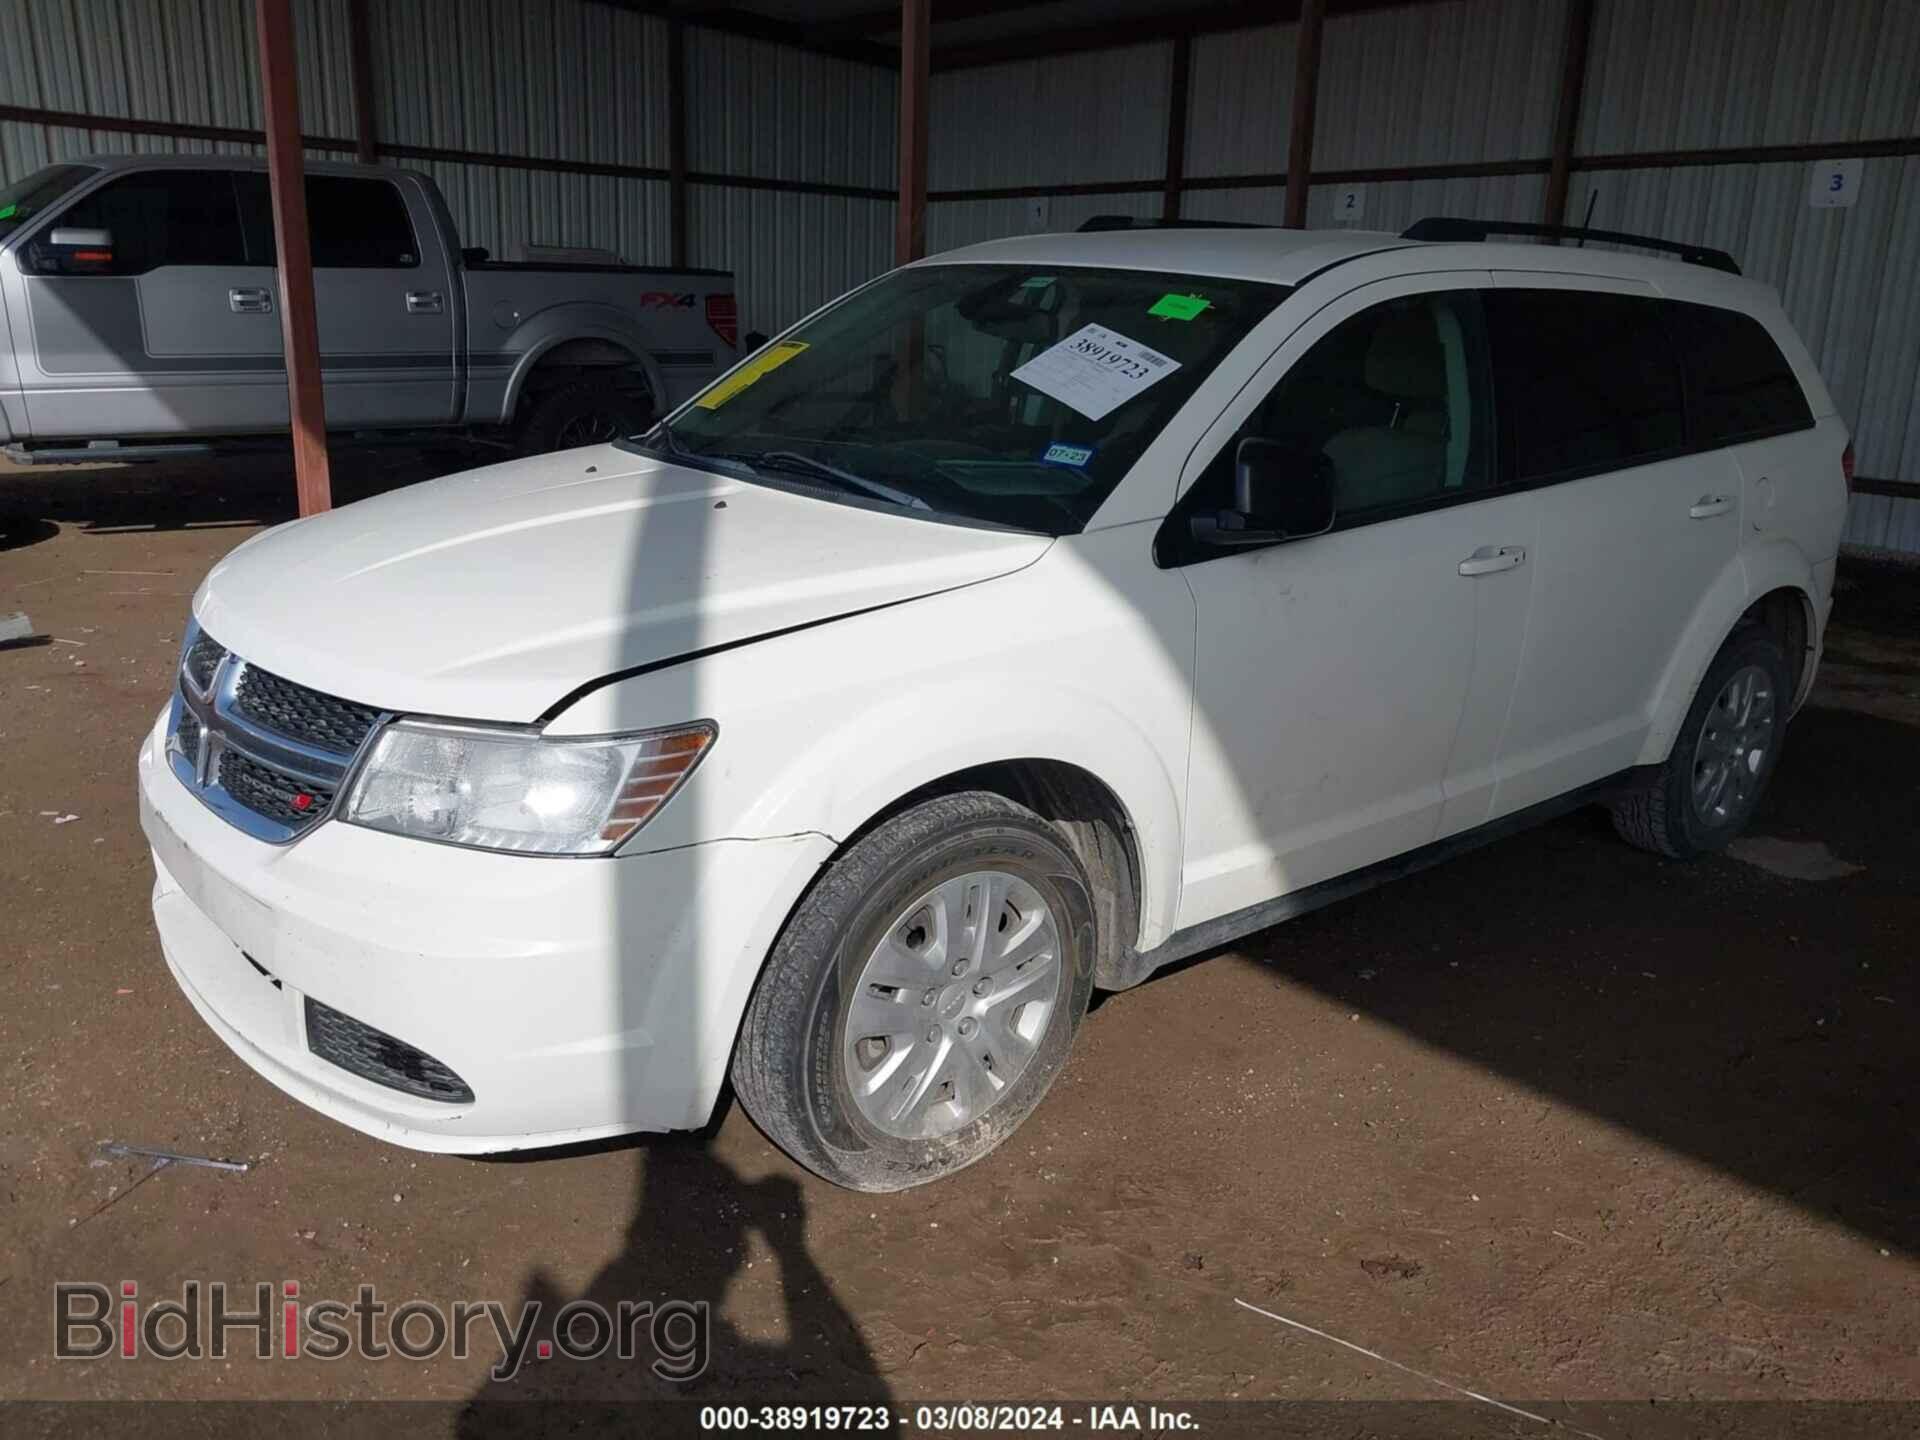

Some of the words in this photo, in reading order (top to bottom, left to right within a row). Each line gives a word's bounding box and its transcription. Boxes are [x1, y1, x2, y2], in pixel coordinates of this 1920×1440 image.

[1829, 174, 1843, 192] 3
[1346, 194, 1355, 208] 2
[640, 291, 697, 309] FX4
[1069, 338, 1150, 380] 38919723
